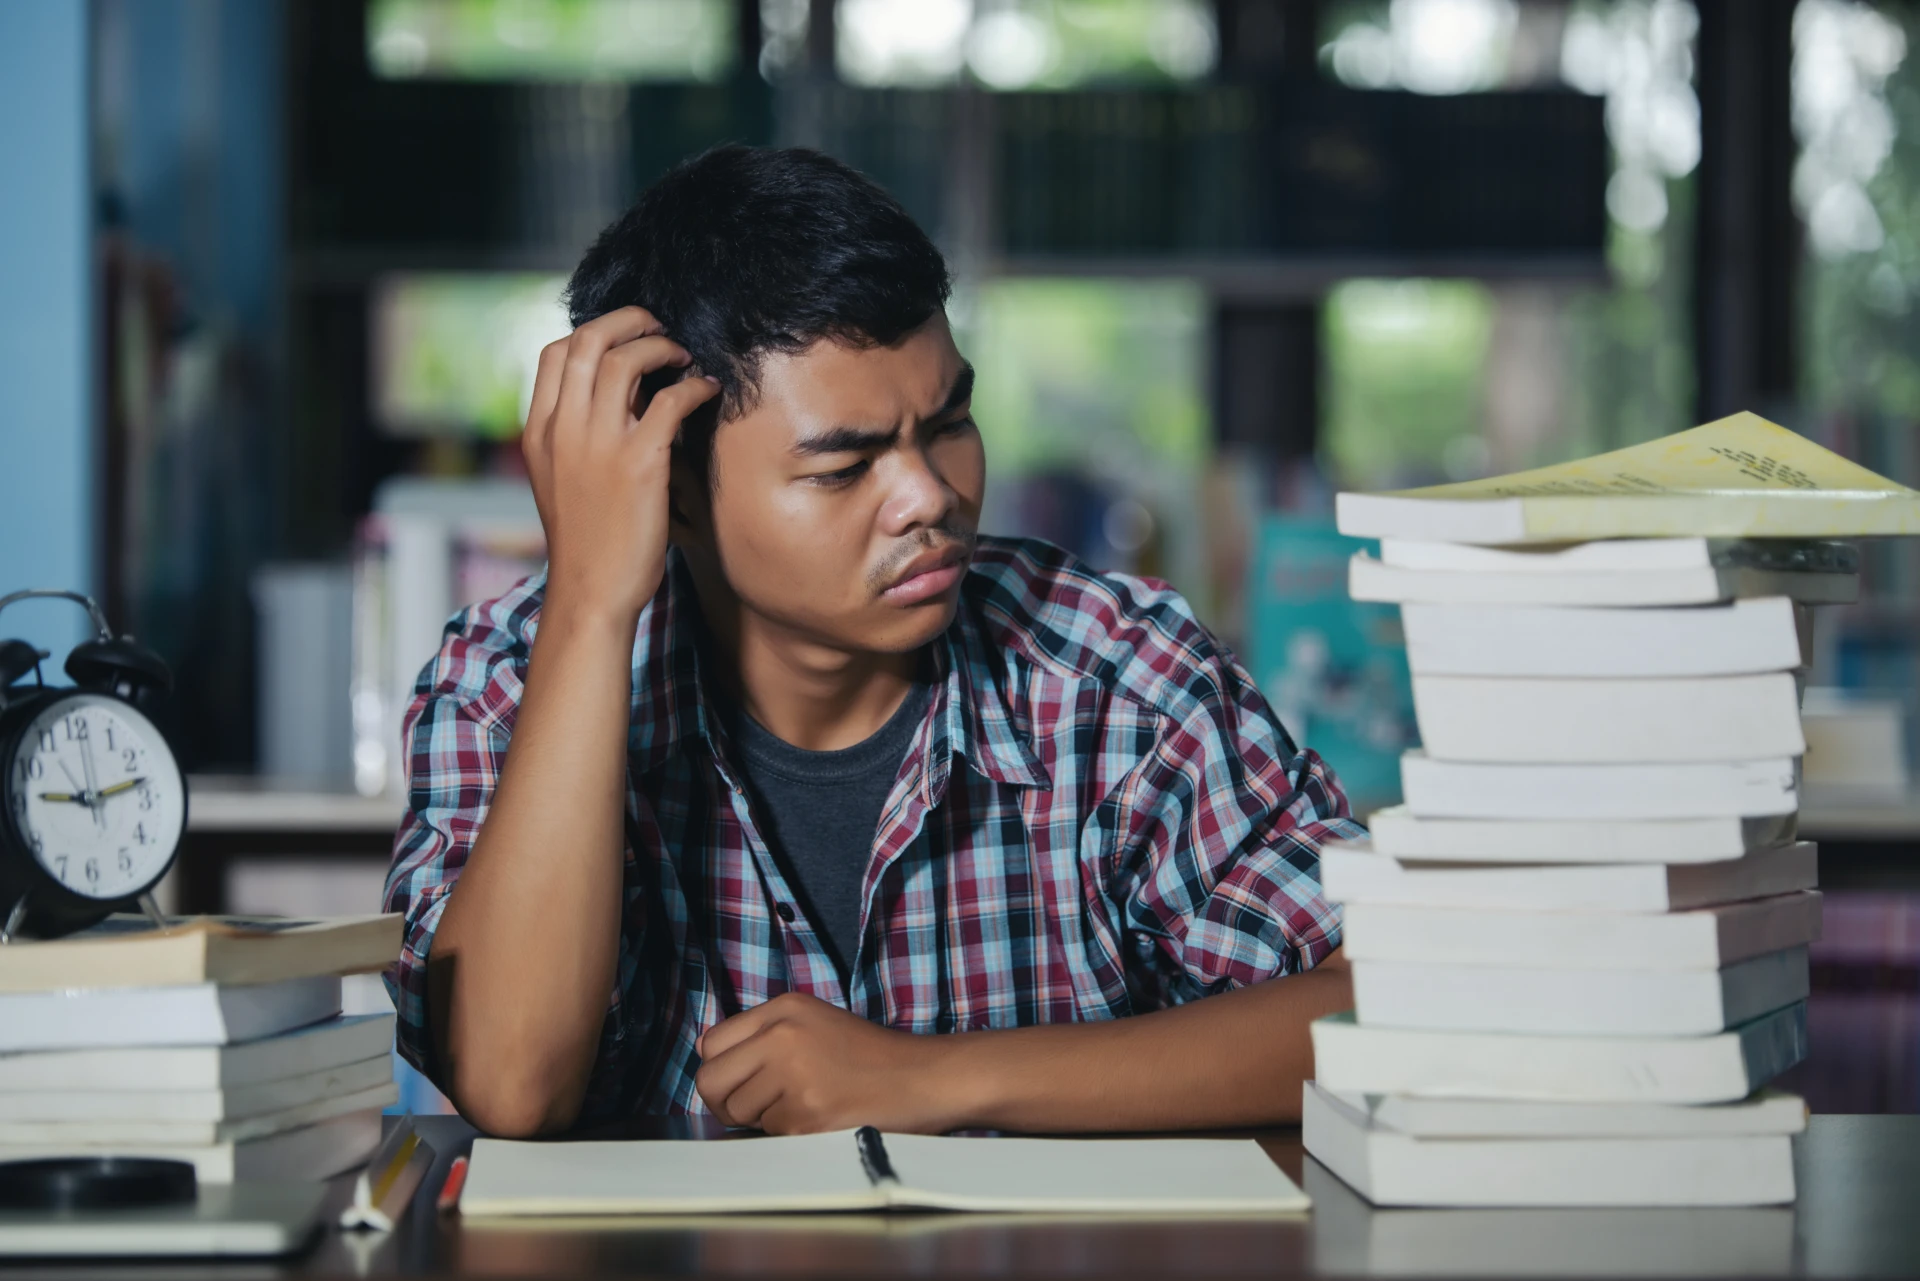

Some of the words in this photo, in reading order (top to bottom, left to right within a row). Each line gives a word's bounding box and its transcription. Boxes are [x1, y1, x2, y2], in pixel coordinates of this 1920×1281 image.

[64, 716, 88, 740] 12
[105, 728, 115, 751] 1
[39, 729, 56, 752] 11
[19, 756, 42, 780] 10
[122, 750, 138, 772] 2
[137, 786, 152, 811] 3
[29, 831, 43, 852] 8
[132, 822, 147, 845] 4
[54, 855, 69, 881] 7
[85, 858, 99, 882] 6
[118, 848, 132, 871] 5
